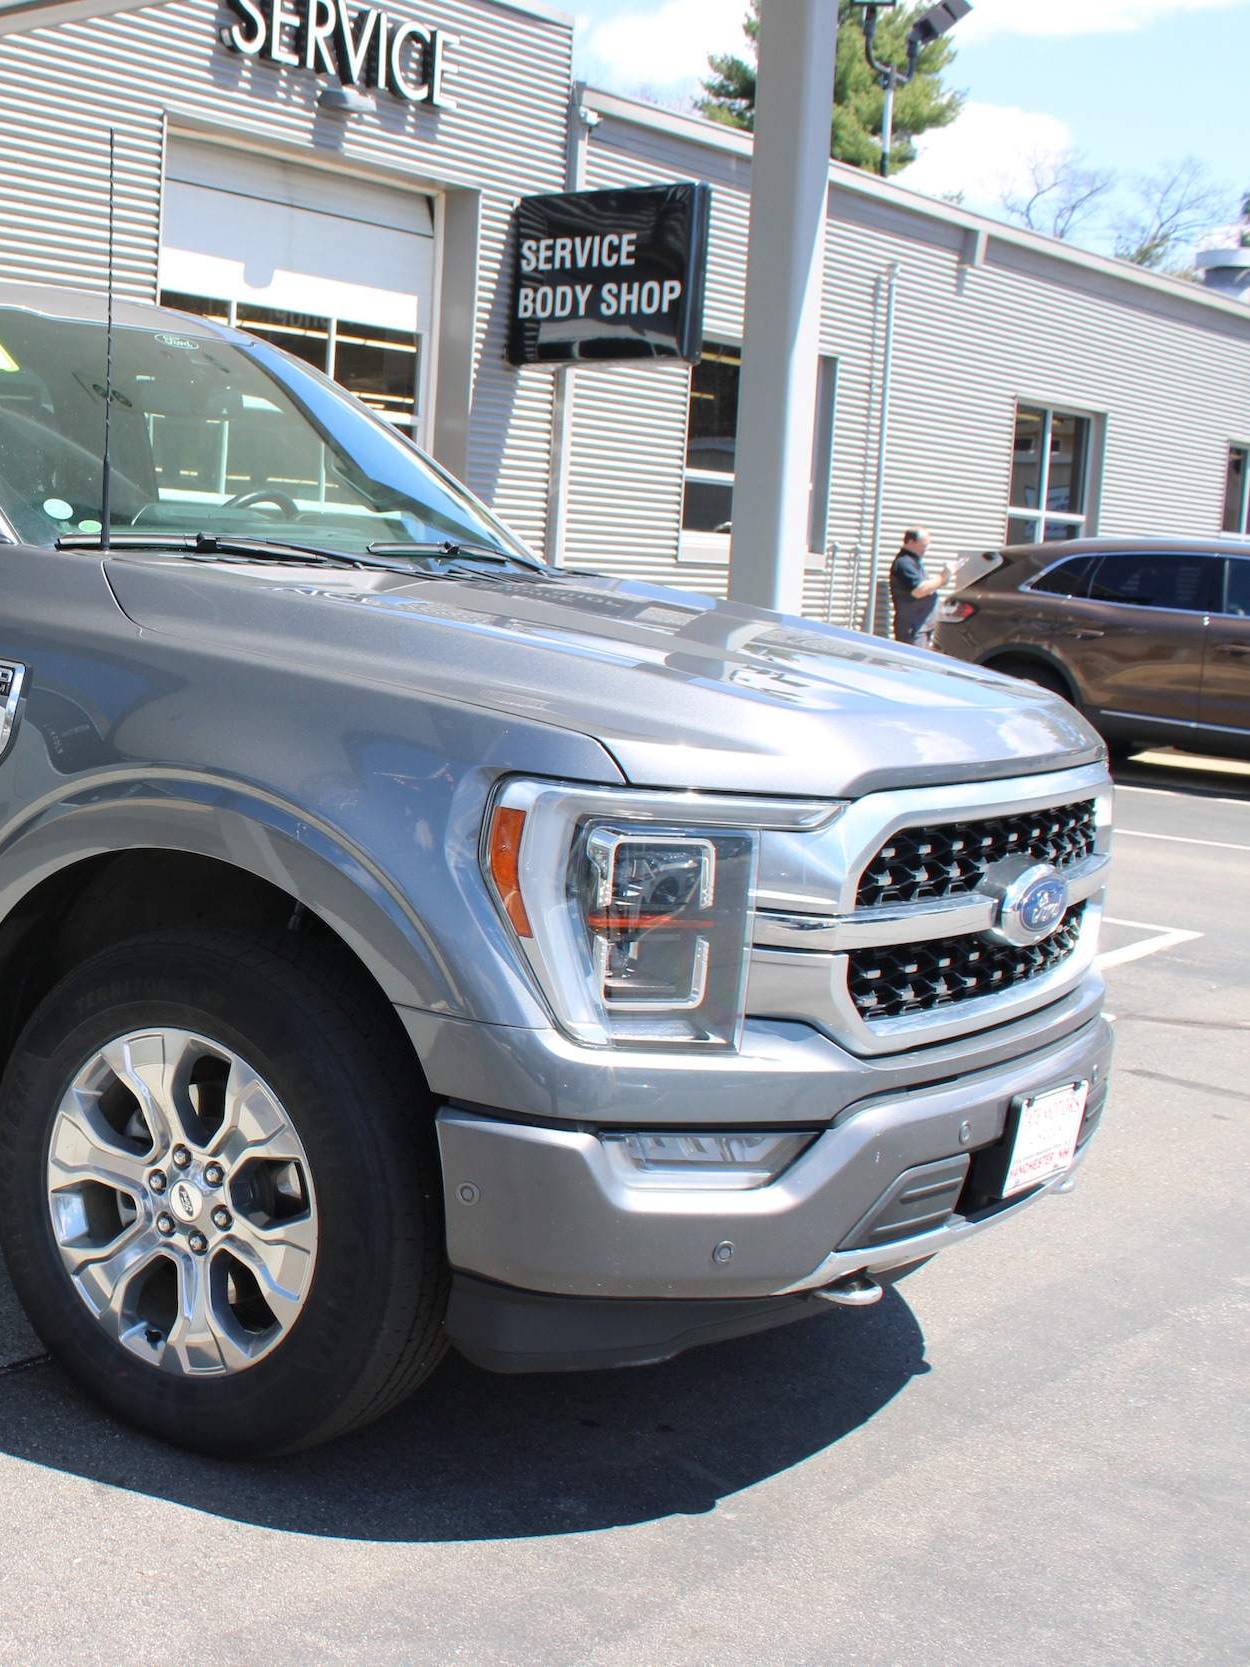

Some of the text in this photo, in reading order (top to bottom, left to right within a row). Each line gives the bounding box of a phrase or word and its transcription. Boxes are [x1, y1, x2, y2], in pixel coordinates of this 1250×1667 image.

[228, 0, 460, 109] SERVICE
[520, 233, 637, 272] SERVICE
[518, 280, 681, 319] BODY SHOP
[1031, 888, 1062, 924] Ford
[1058, 1147, 1070, 1159] NH
